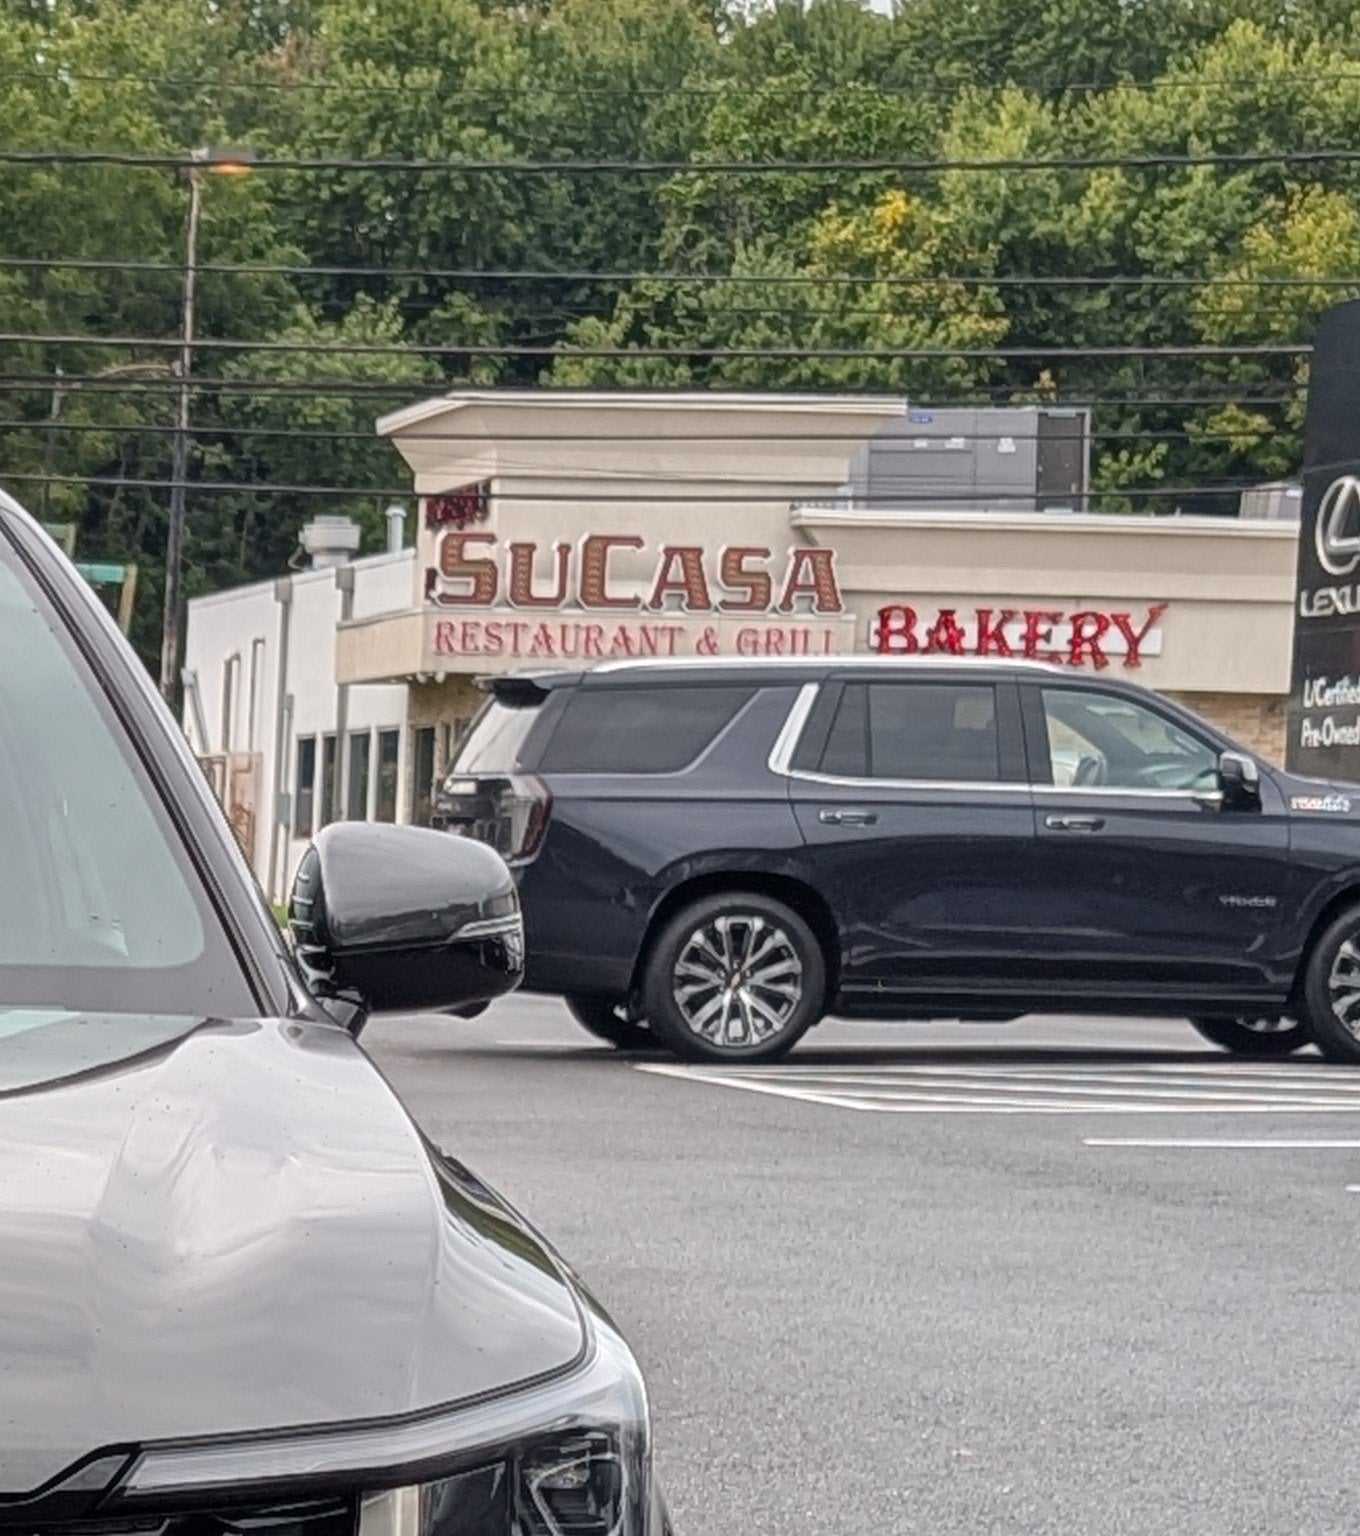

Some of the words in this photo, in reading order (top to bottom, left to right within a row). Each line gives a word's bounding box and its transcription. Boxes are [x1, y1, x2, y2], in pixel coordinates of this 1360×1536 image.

[1300, 585, 1360, 617] LEXU
[435, 621, 685, 659] RESTAURANT
[695, 626, 720, 657] &
[735, 627, 840, 657] GRILL
[874, 603, 1169, 671] BAKERY
